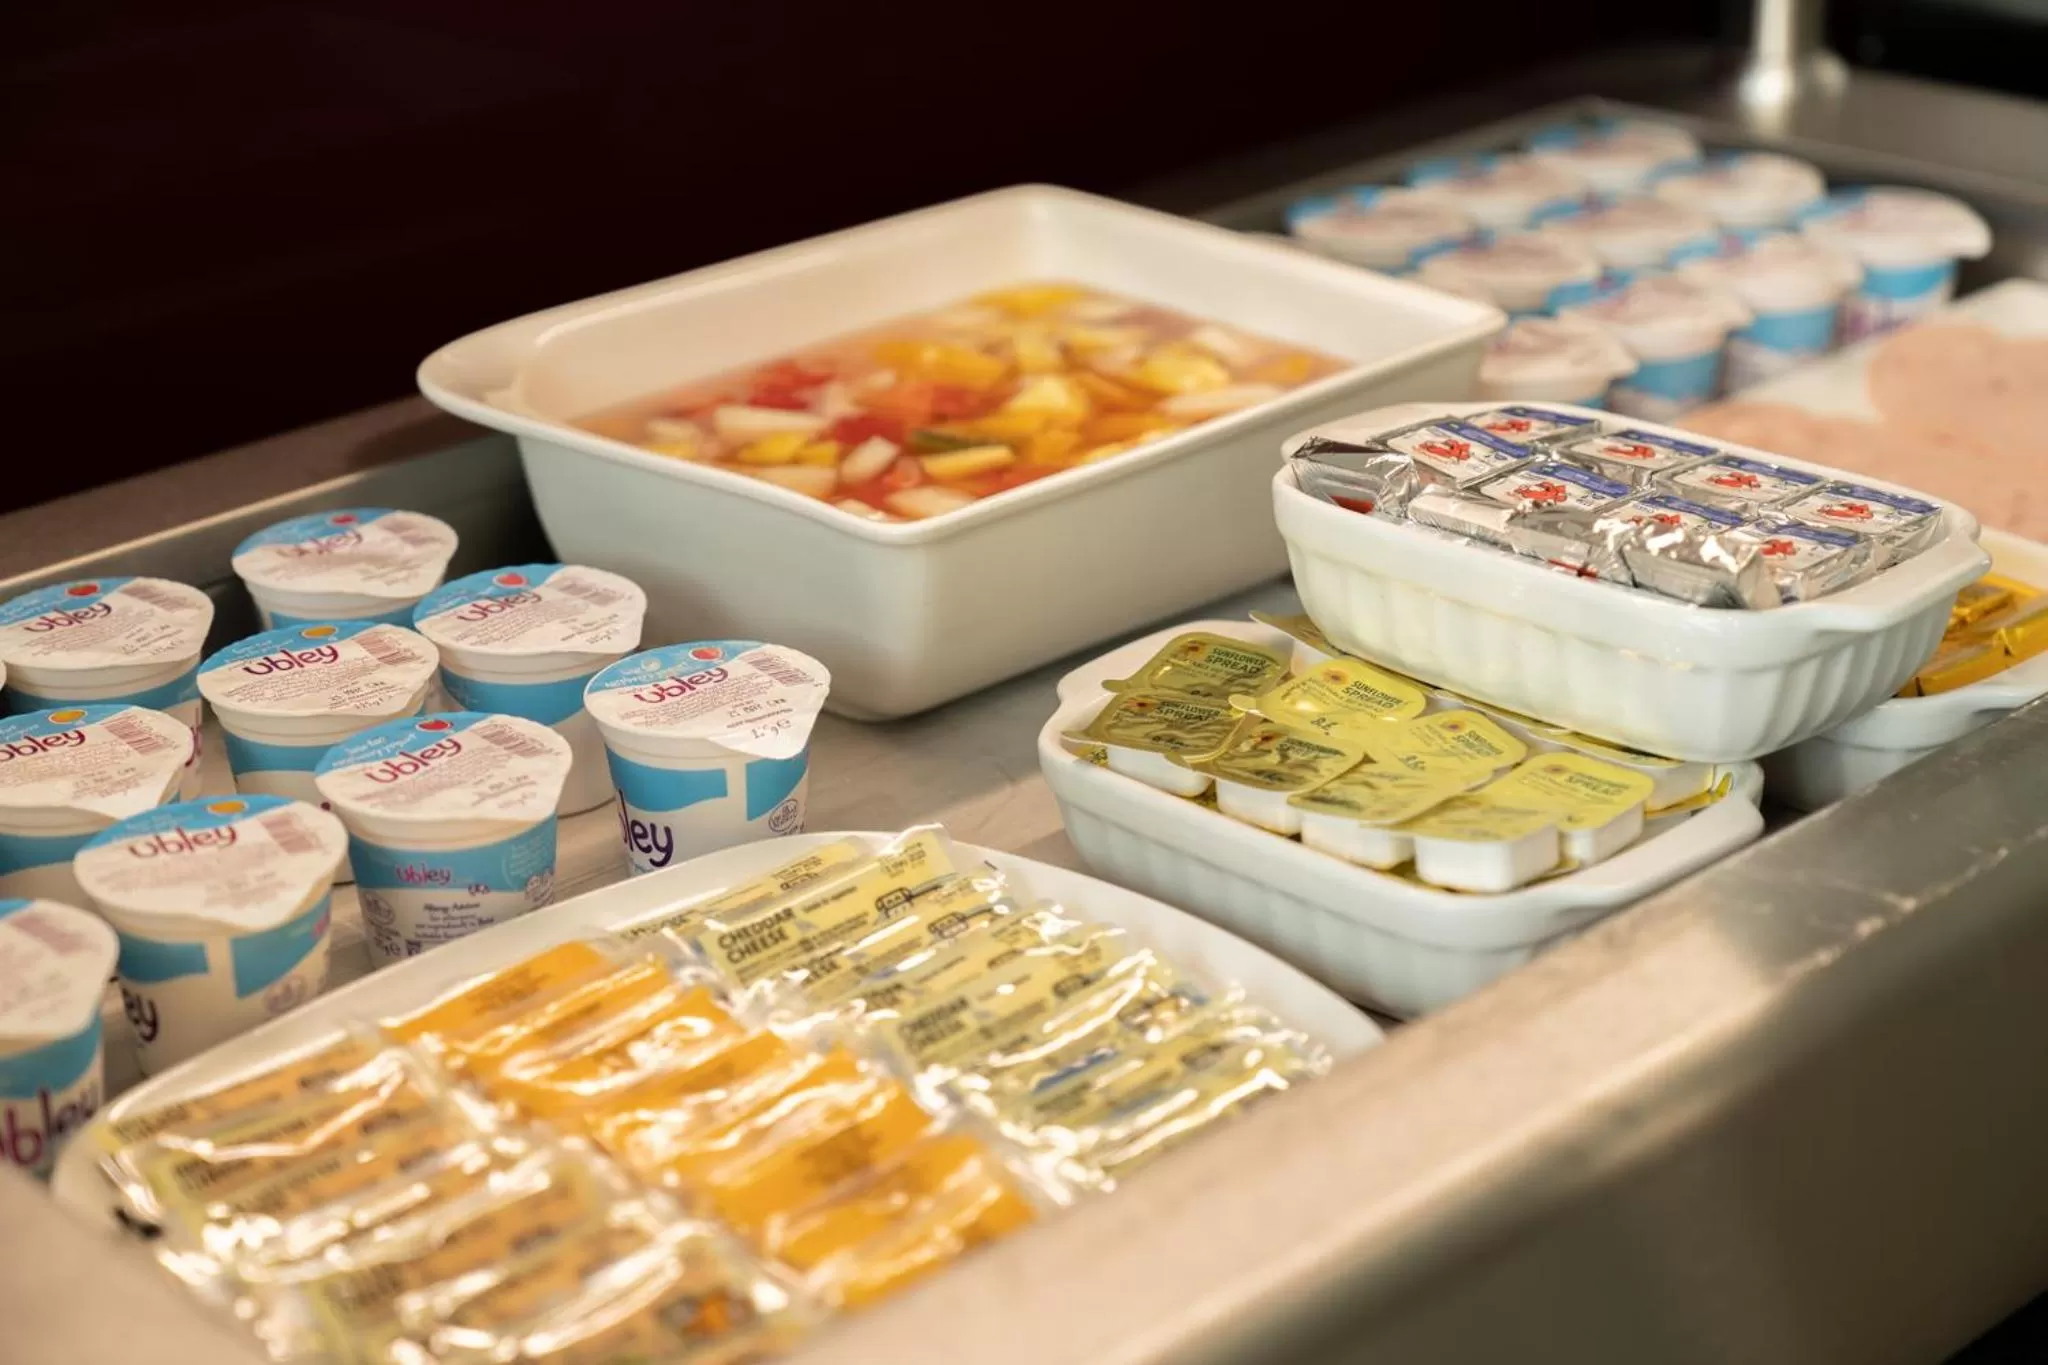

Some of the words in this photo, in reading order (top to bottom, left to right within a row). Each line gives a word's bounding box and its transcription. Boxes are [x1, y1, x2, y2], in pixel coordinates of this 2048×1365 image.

[1206, 654, 1261, 674] SPREAD
[1341, 687, 1395, 709] SPREAD
[1351, 680, 1404, 705] SUNFLOWER
[717, 907, 796, 950] CHEDDAR
[726, 926, 789, 965] CHEESE
